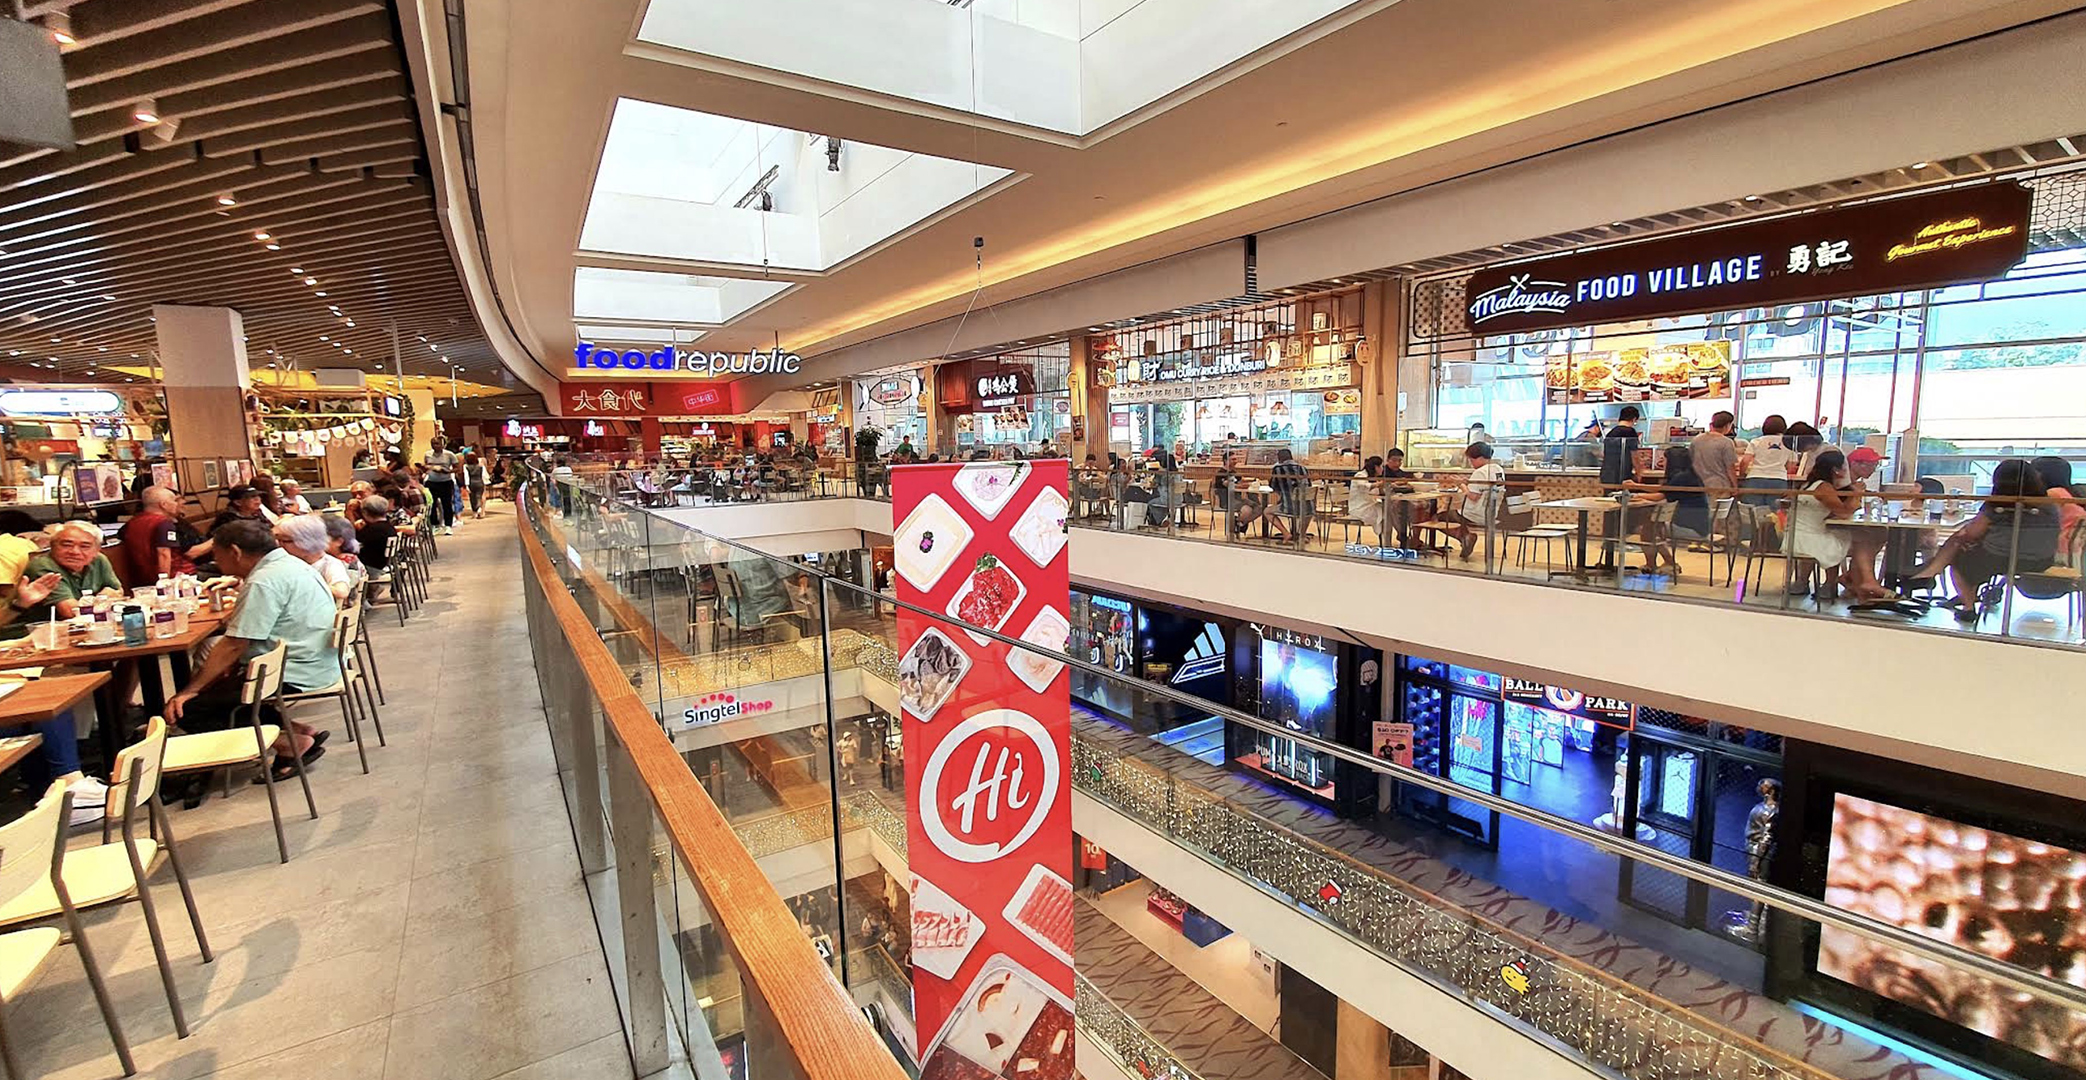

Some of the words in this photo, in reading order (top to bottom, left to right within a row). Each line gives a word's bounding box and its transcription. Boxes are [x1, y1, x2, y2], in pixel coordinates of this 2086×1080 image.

[1888, 239, 1942, 261] Gourmet
[1942, 225, 2015, 248] Experience
[1917, 217, 1978, 238] Authentic
[1787, 240, 1854, 274] 勇記
[1469, 286, 1571, 318] Malaysia
[1577, 274, 1638, 302] FOOD
[1648, 255, 1762, 294] VILLAGE
[1161, 370, 1177, 380] OMU
[1227, 359, 1265, 373] DONBURI
[572, 389, 646, 411] 大食代
[1505, 678, 1544, 692] BALL
[1585, 696, 1629, 711] PARK
[952, 741, 1030, 835] Hi
